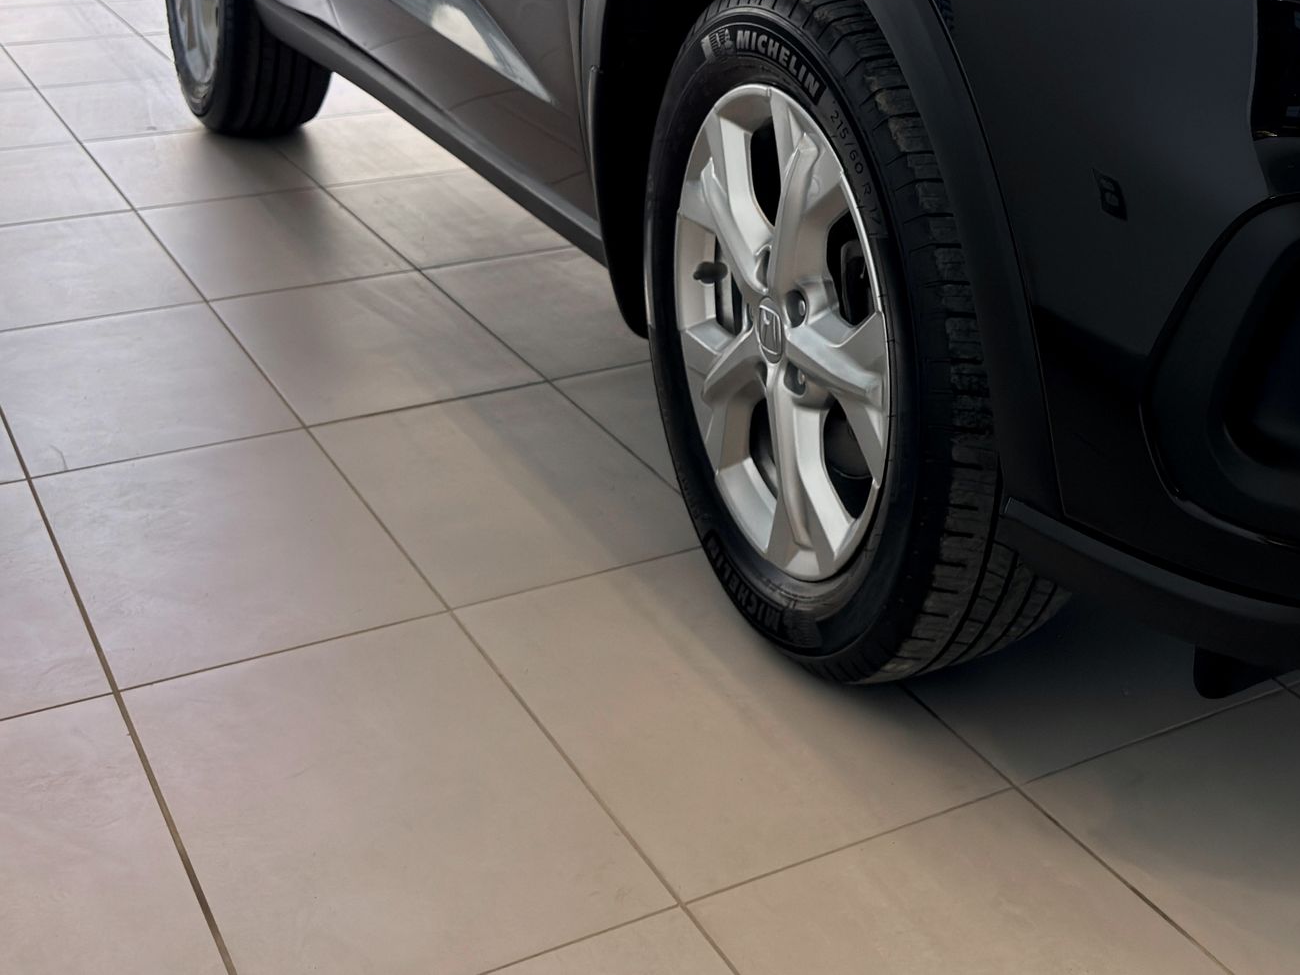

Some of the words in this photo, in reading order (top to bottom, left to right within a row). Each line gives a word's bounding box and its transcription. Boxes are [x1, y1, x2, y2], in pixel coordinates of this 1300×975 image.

[735, 29, 820, 99] MICHELIN
[830, 110, 865, 175] 215/60
[862, 180, 872, 195] R
